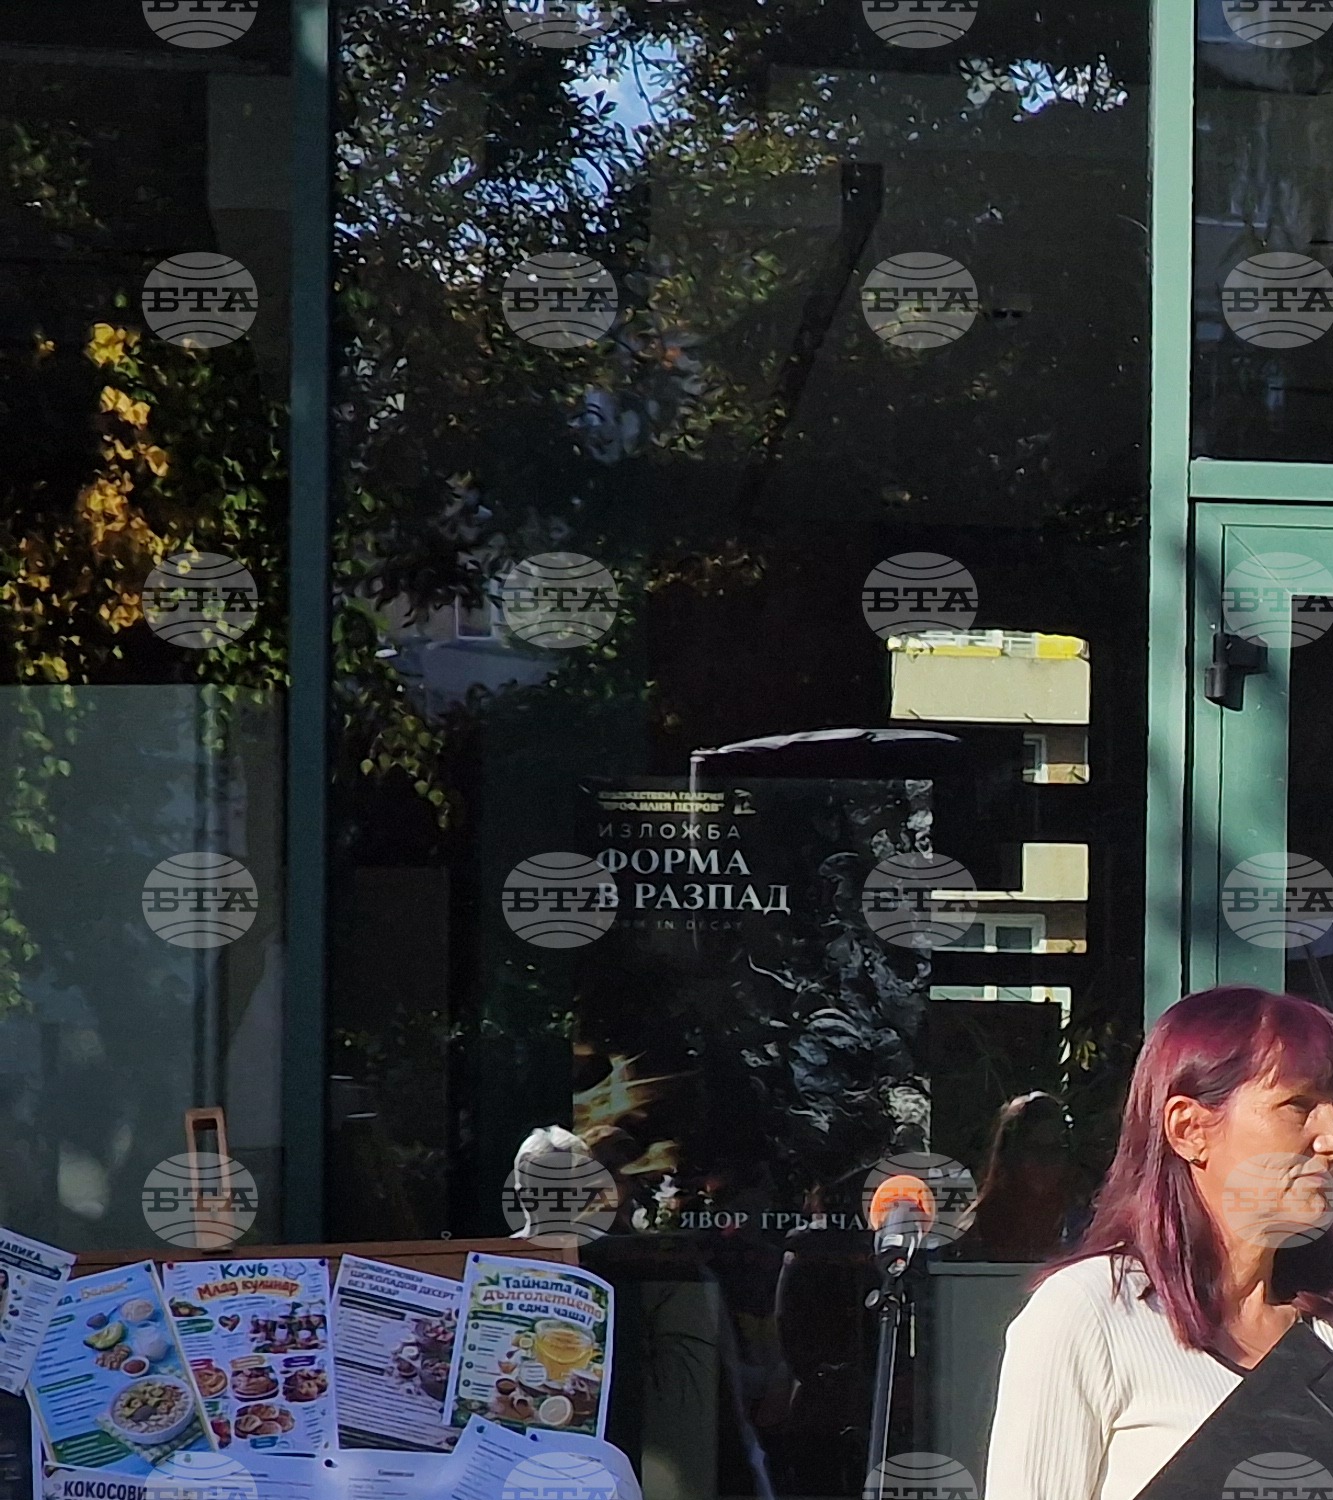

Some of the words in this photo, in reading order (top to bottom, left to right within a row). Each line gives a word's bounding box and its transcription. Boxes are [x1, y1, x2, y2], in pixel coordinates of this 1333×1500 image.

[599, 821, 741, 840] ИЗЛОЖБА
[597, 848, 751, 875] ФОРМА
[598, 882, 619, 908] В
[634, 883, 791, 916] РАЗПАД
[680, 1211, 748, 1229] ЯВОР
[219, 1262, 269, 1279] Клуб
[197, 1281, 238, 1299] Млад
[242, 1279, 300, 1297] кулинар
[502, 1276, 572, 1294] Тайната
[575, 1287, 589, 1300] на
